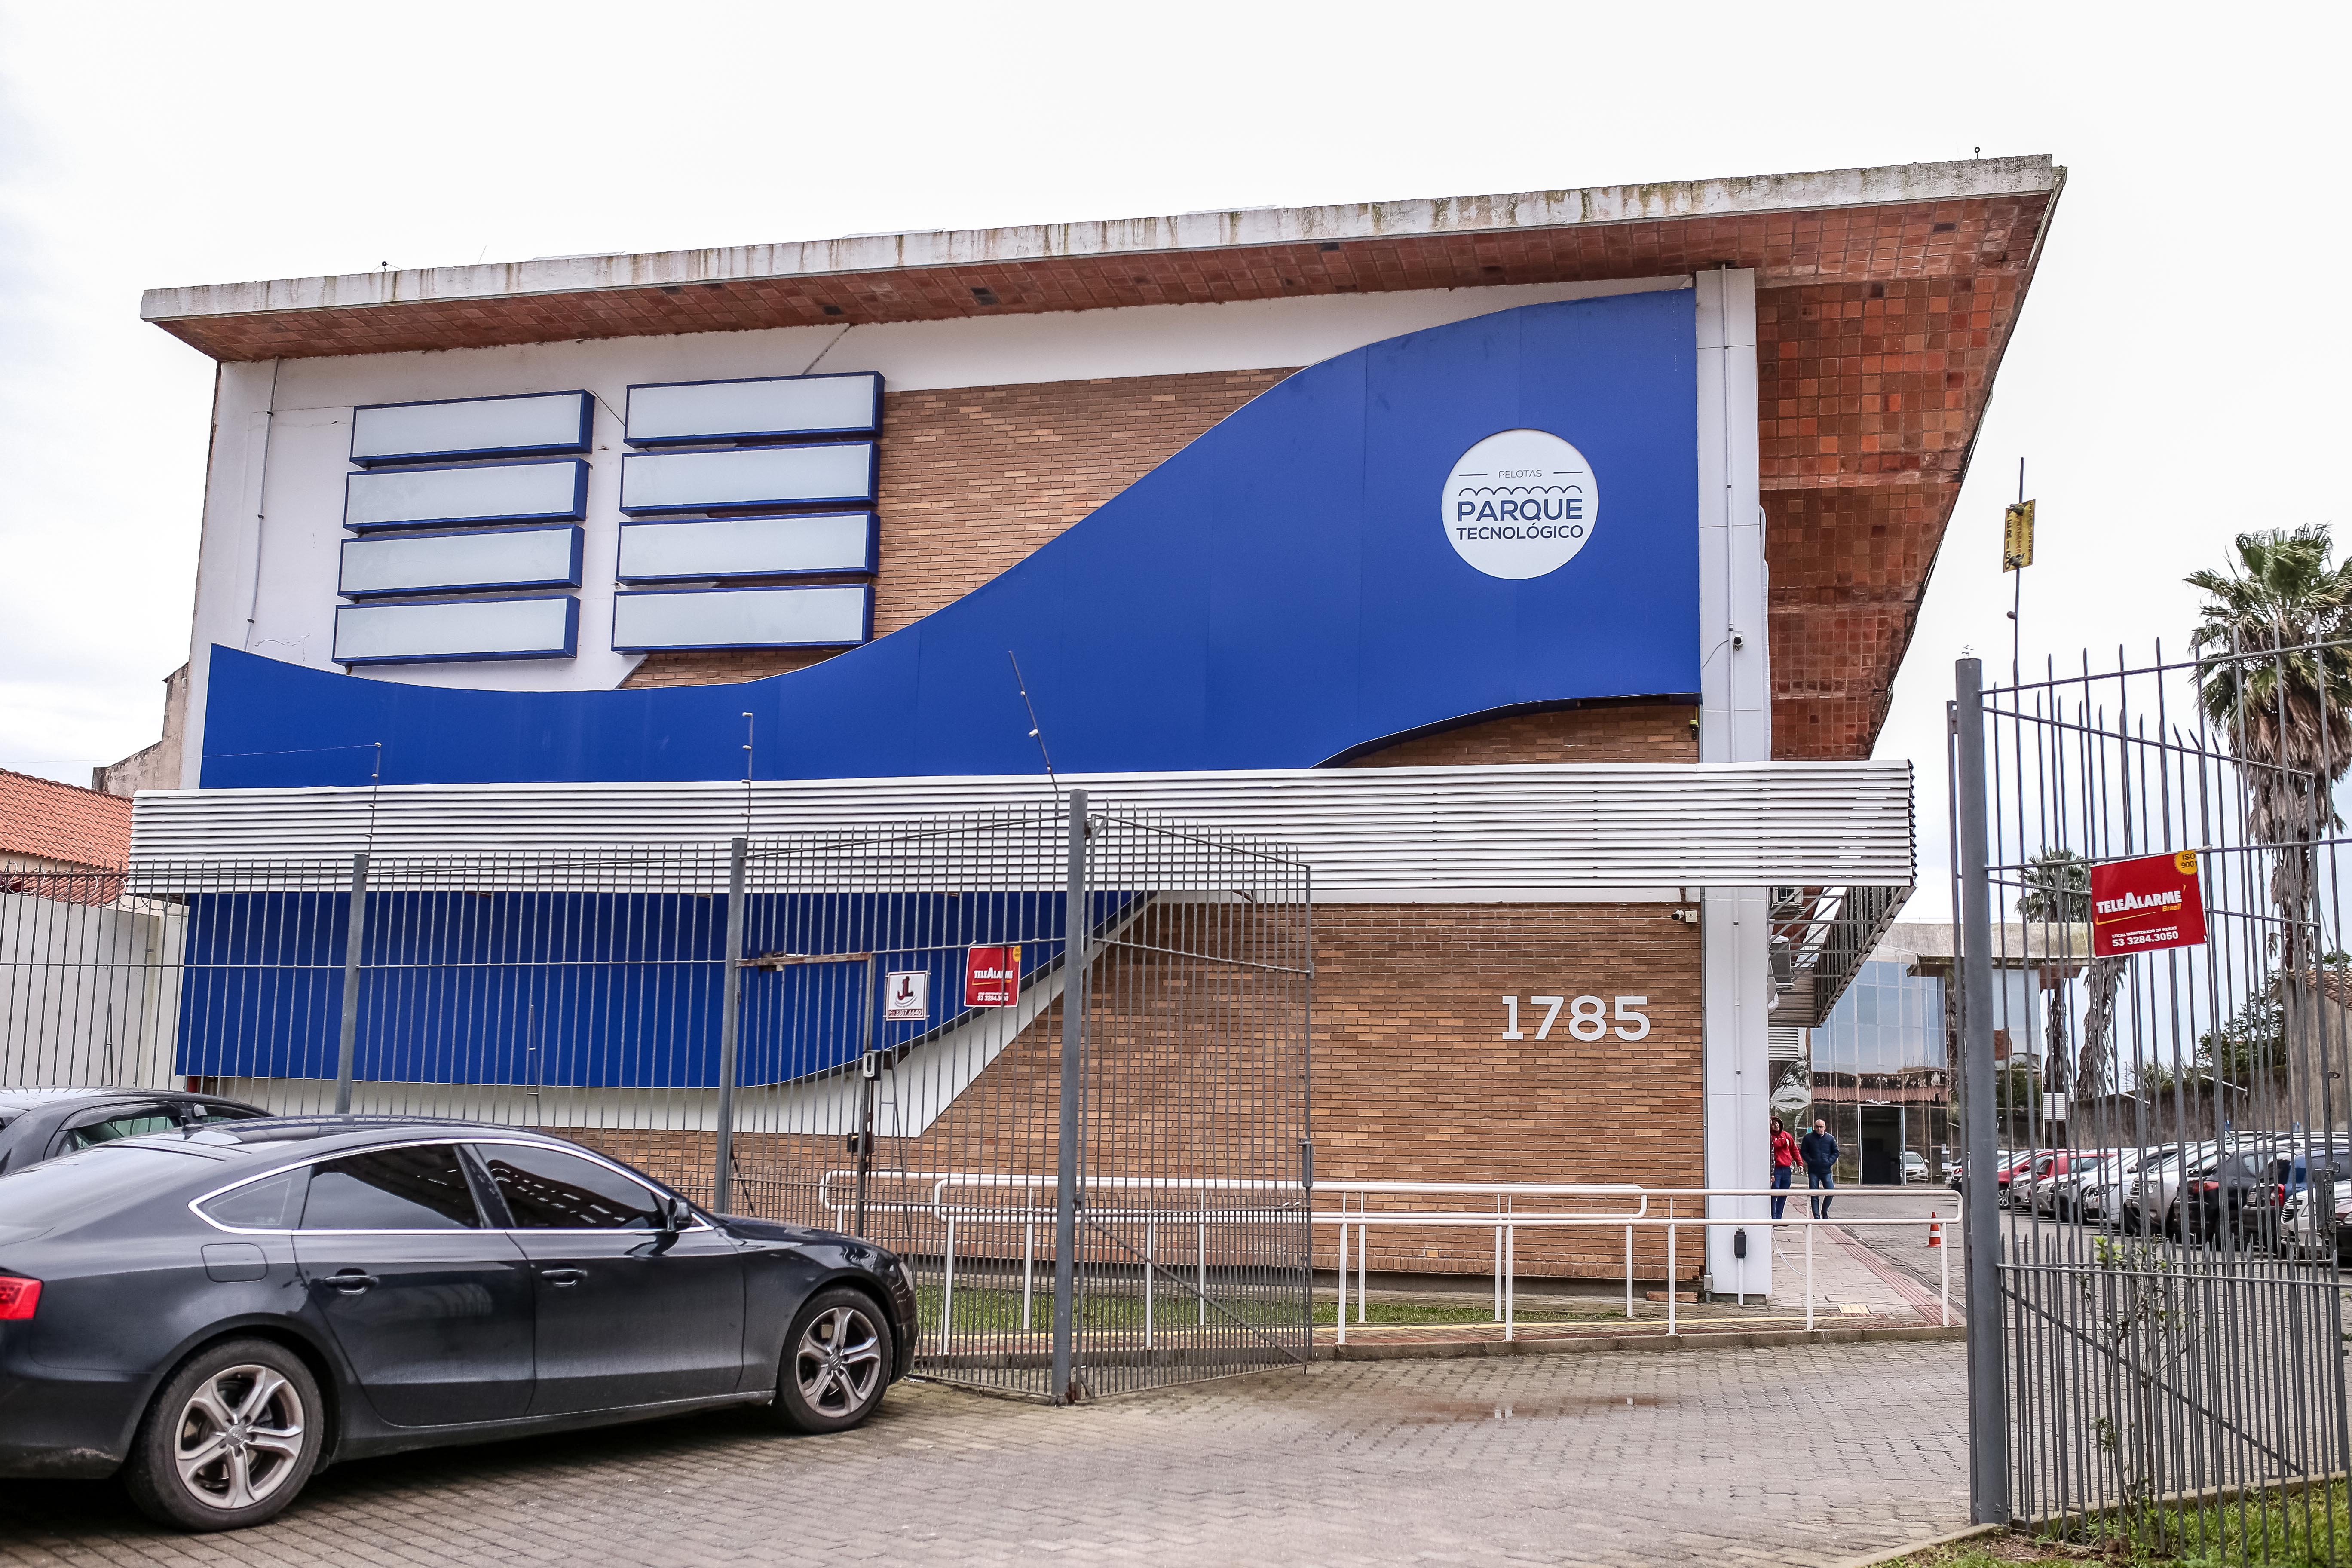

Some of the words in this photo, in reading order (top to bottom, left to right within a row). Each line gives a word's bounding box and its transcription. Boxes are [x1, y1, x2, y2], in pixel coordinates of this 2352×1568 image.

[1498, 469, 1542, 478] PELOTAS
[1458, 499, 1583, 522] PARQUE
[1456, 522, 1583, 540] TECNOLÓGICO
[2162, 903, 2181, 912] Brasil
[2112, 938, 2125, 947] 53
[2127, 931, 2179, 945] 3284.3050
[1502, 995, 1651, 1041] 1785
